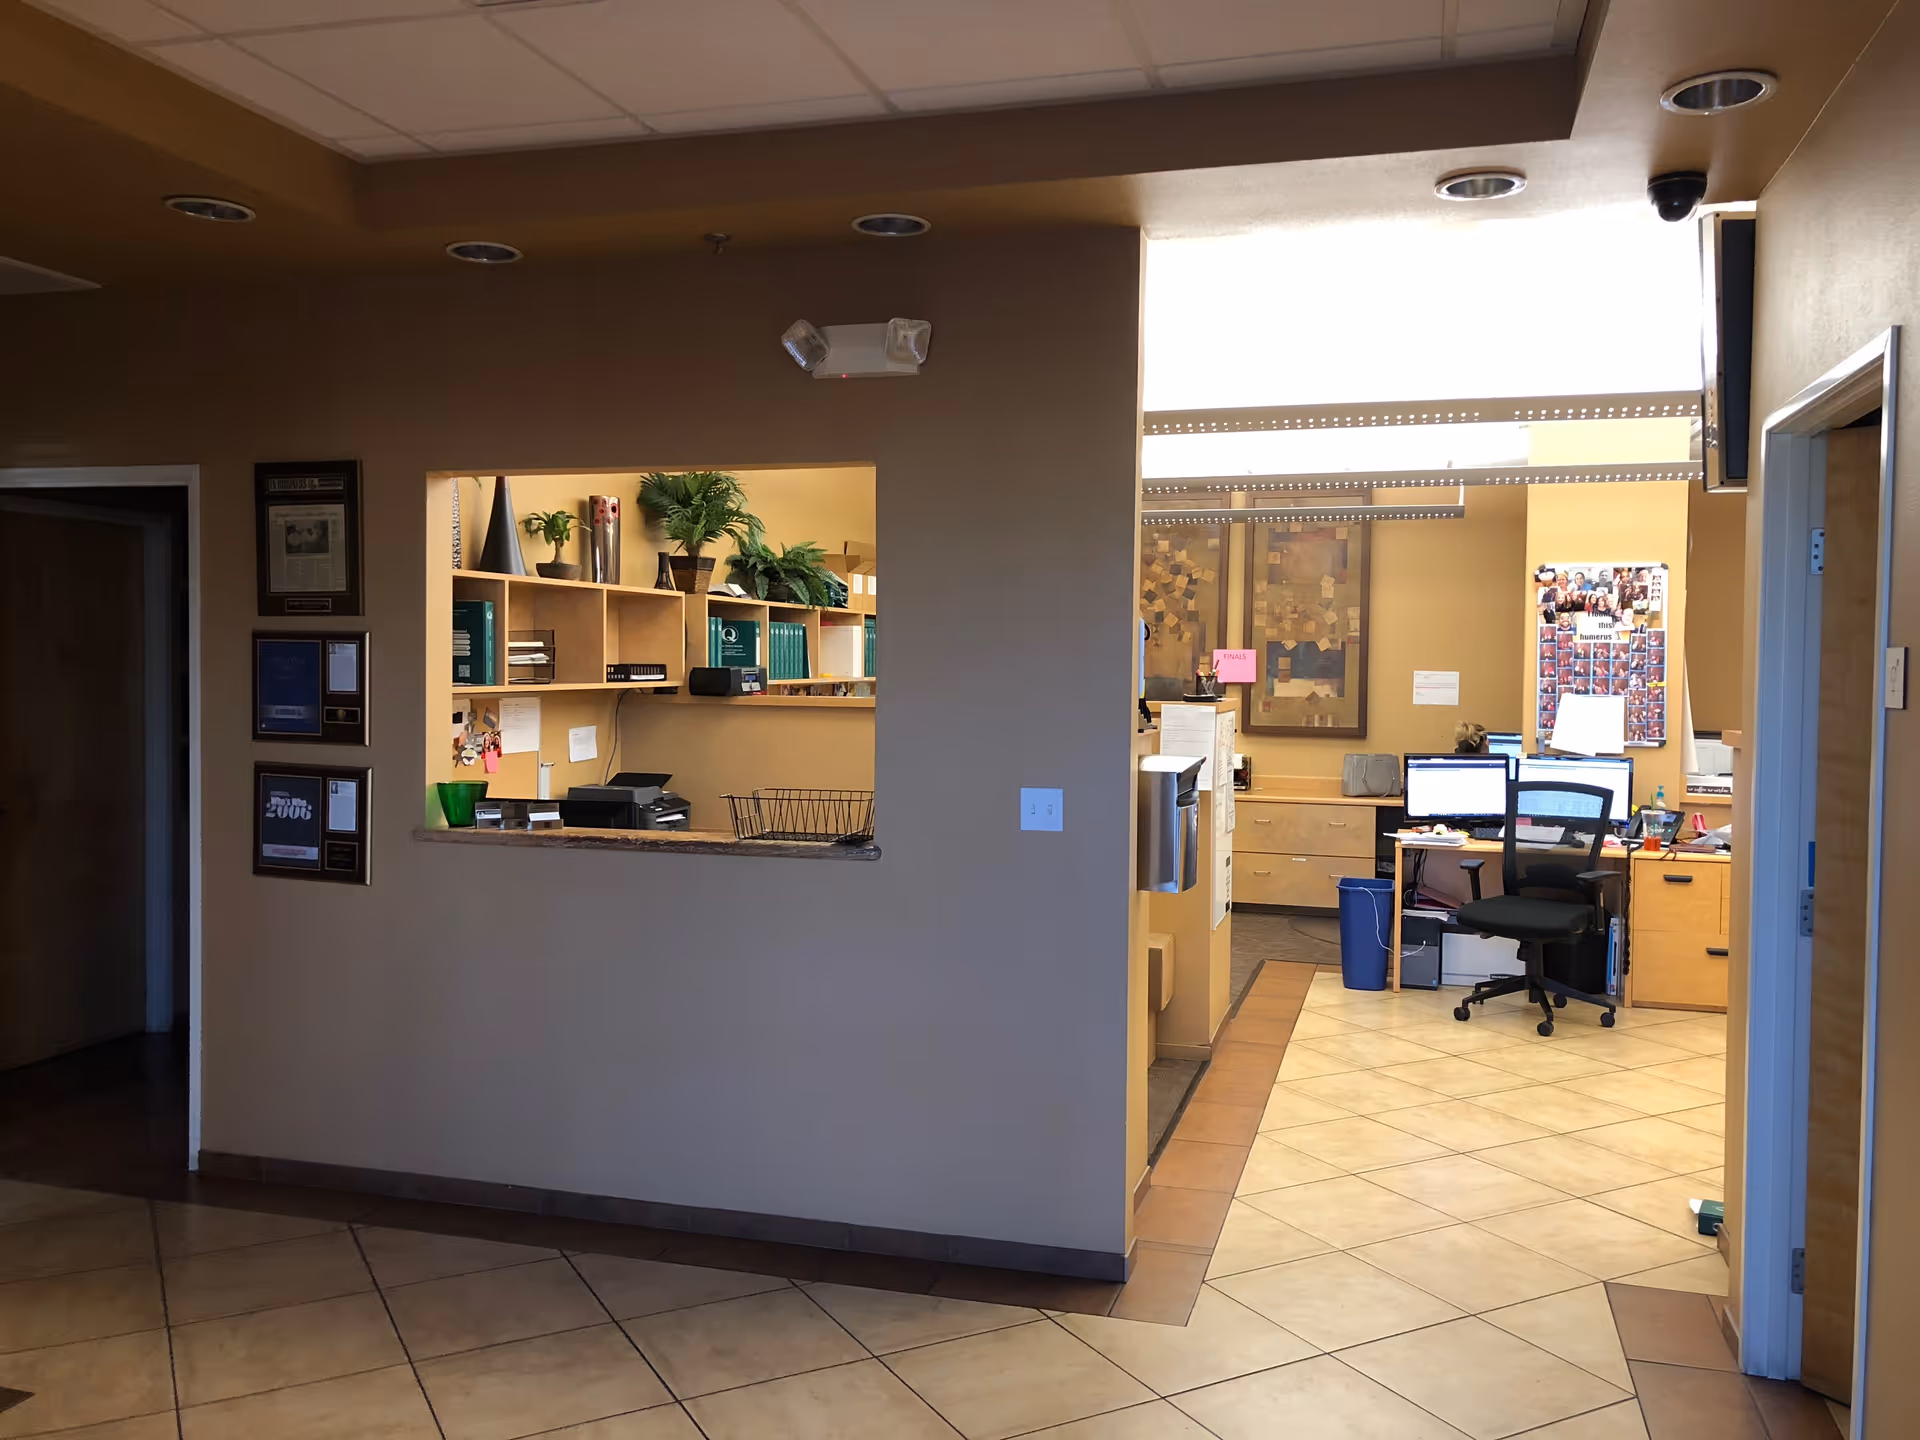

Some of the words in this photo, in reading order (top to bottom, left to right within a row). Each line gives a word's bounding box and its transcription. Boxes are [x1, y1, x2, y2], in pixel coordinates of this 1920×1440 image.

[721, 627, 737, 642] Q
[270, 796, 291, 807] Who's
[291, 797, 308, 807] Who
[265, 801, 312, 820] 2006
